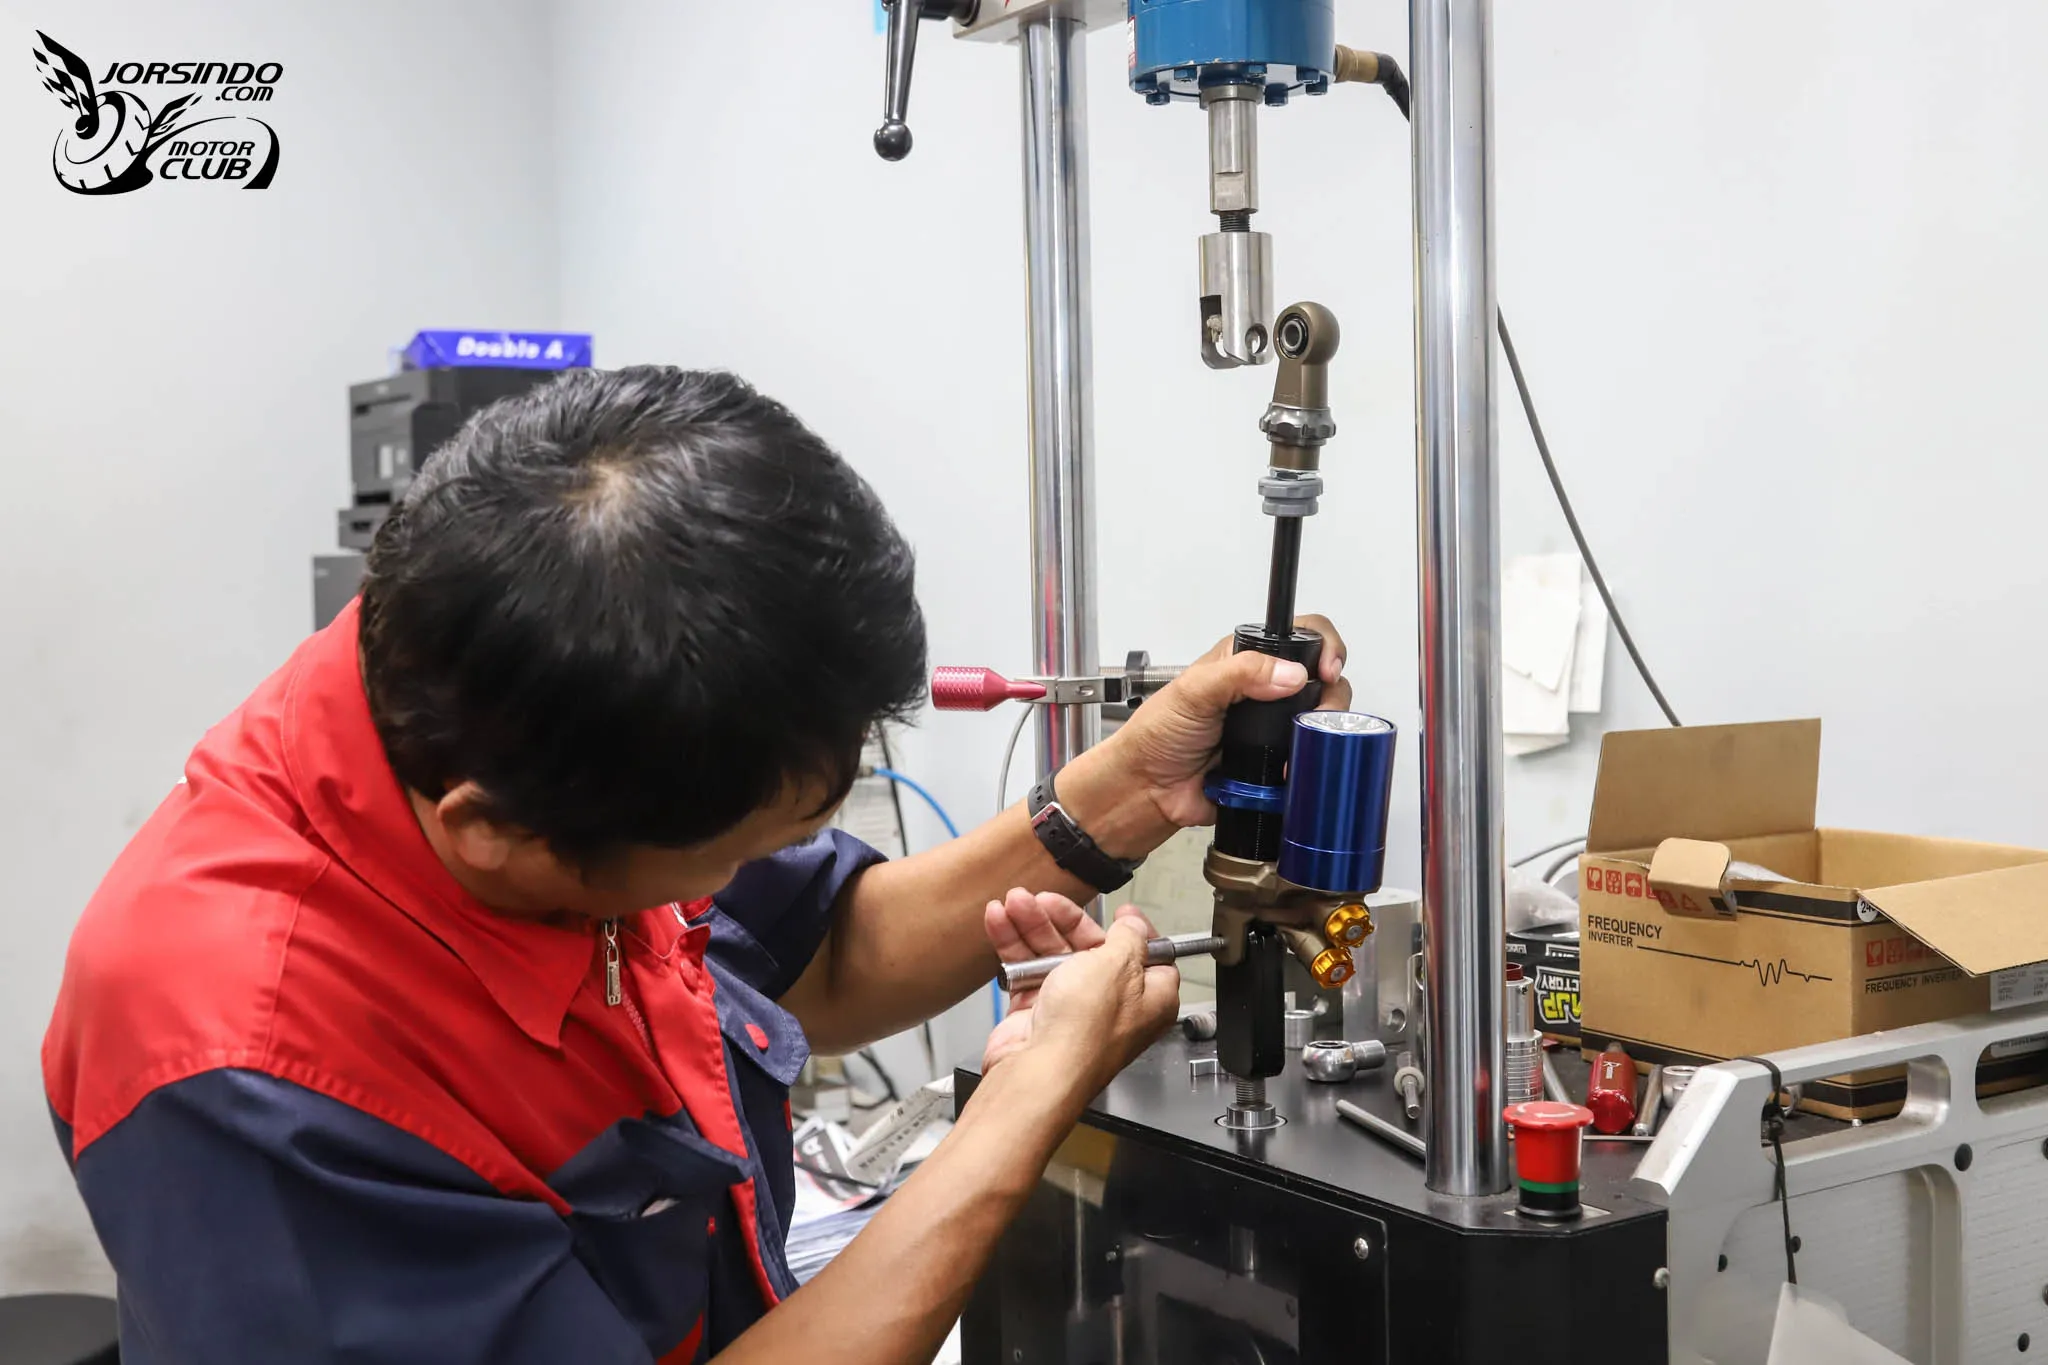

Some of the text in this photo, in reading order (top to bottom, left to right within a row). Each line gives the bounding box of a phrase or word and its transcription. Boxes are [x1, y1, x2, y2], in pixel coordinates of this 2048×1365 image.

[544, 339, 564, 360] A
[1588, 915, 1662, 940] FREQUENCY
[1588, 930, 1634, 948] INVERTER
[1865, 978, 1918, 994] FREQUENCY
